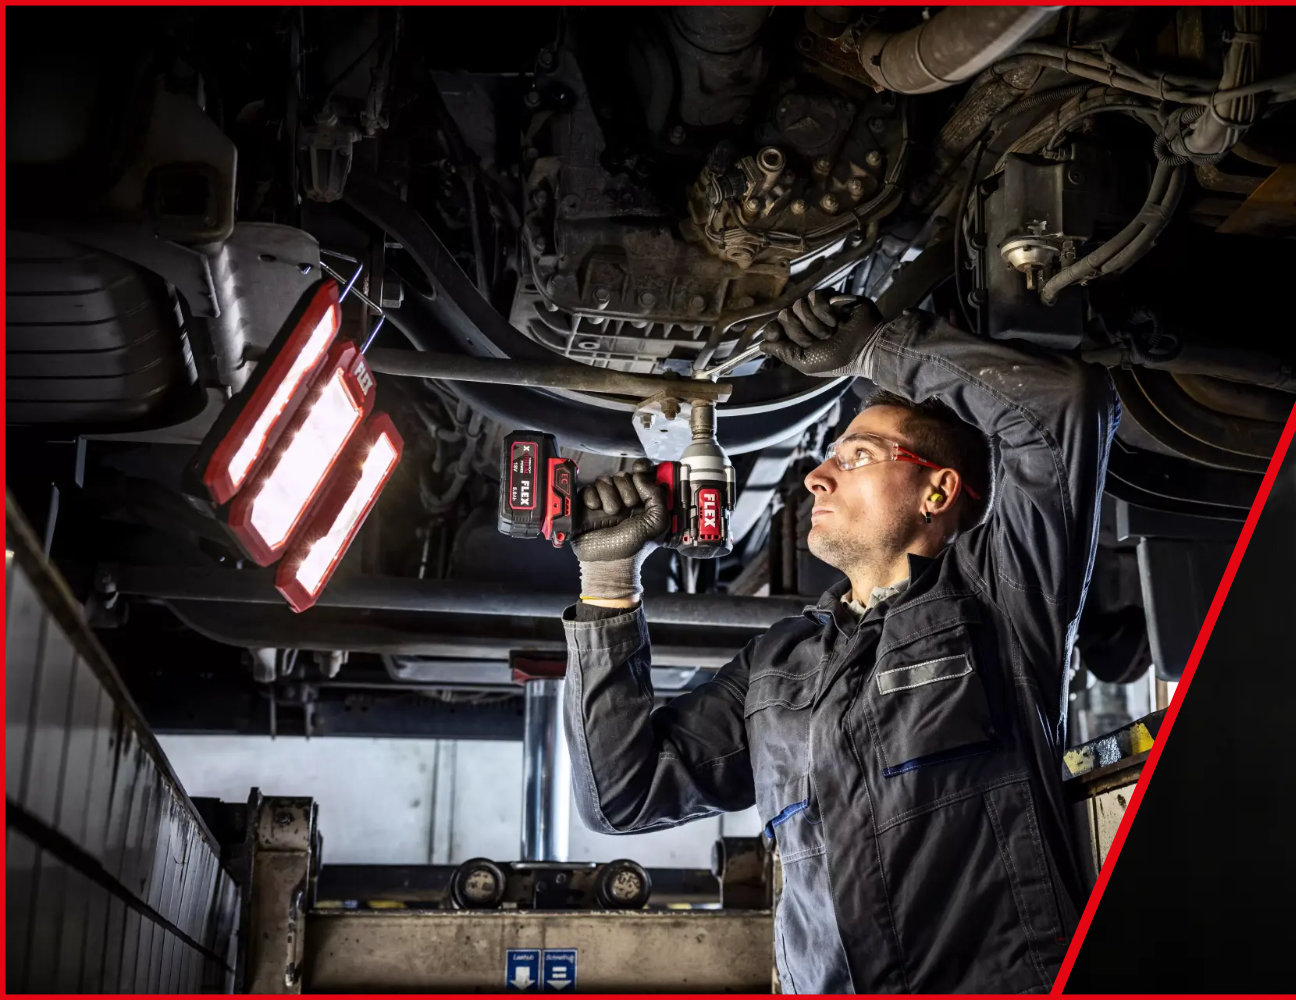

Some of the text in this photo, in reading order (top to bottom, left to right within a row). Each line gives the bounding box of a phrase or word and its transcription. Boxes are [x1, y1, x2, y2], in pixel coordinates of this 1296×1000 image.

[354, 361, 373, 396] FLEX
[520, 480, 530, 506] FLEX
[561, 473, 569, 484] EC
[703, 493, 716, 528] FLEX
